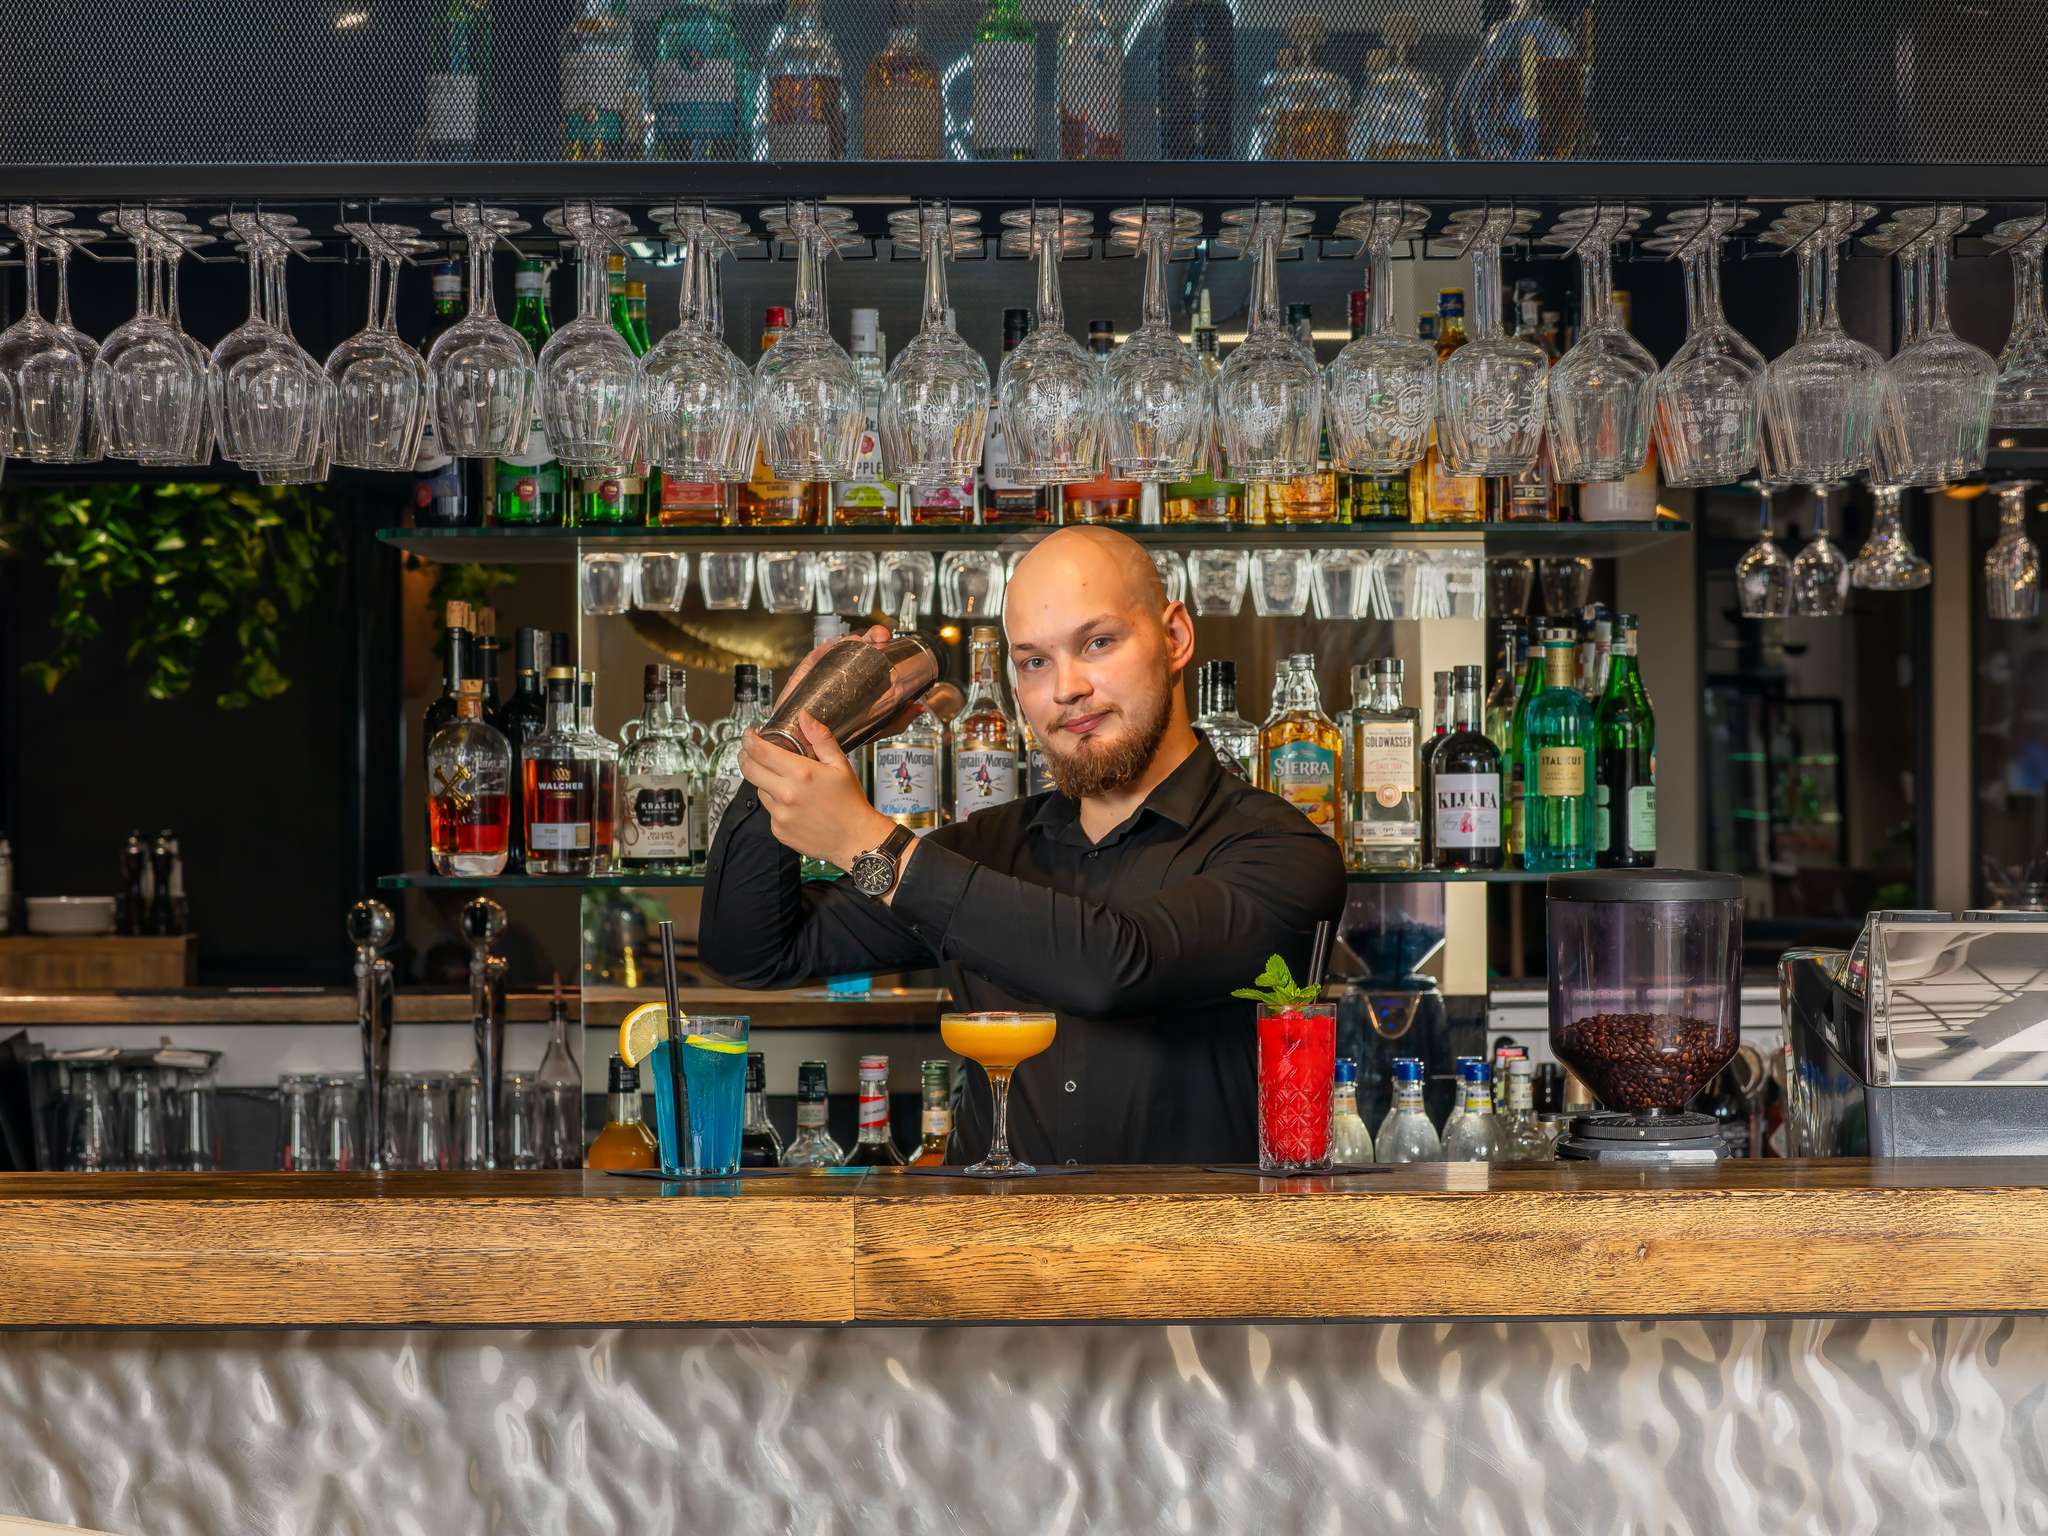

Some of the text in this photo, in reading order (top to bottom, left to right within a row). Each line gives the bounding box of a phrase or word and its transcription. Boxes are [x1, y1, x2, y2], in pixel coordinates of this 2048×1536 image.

[856, 462, 883, 475] PPLE
[1525, 487, 1536, 497] 12
[1365, 736, 1413, 748] GOLDWASSER
[1542, 756, 1582, 765] ITALCUS
[1273, 758, 1331, 777] SIERRA
[538, 782, 584, 790] WALCHER
[640, 802, 681, 810] KRAKEN
